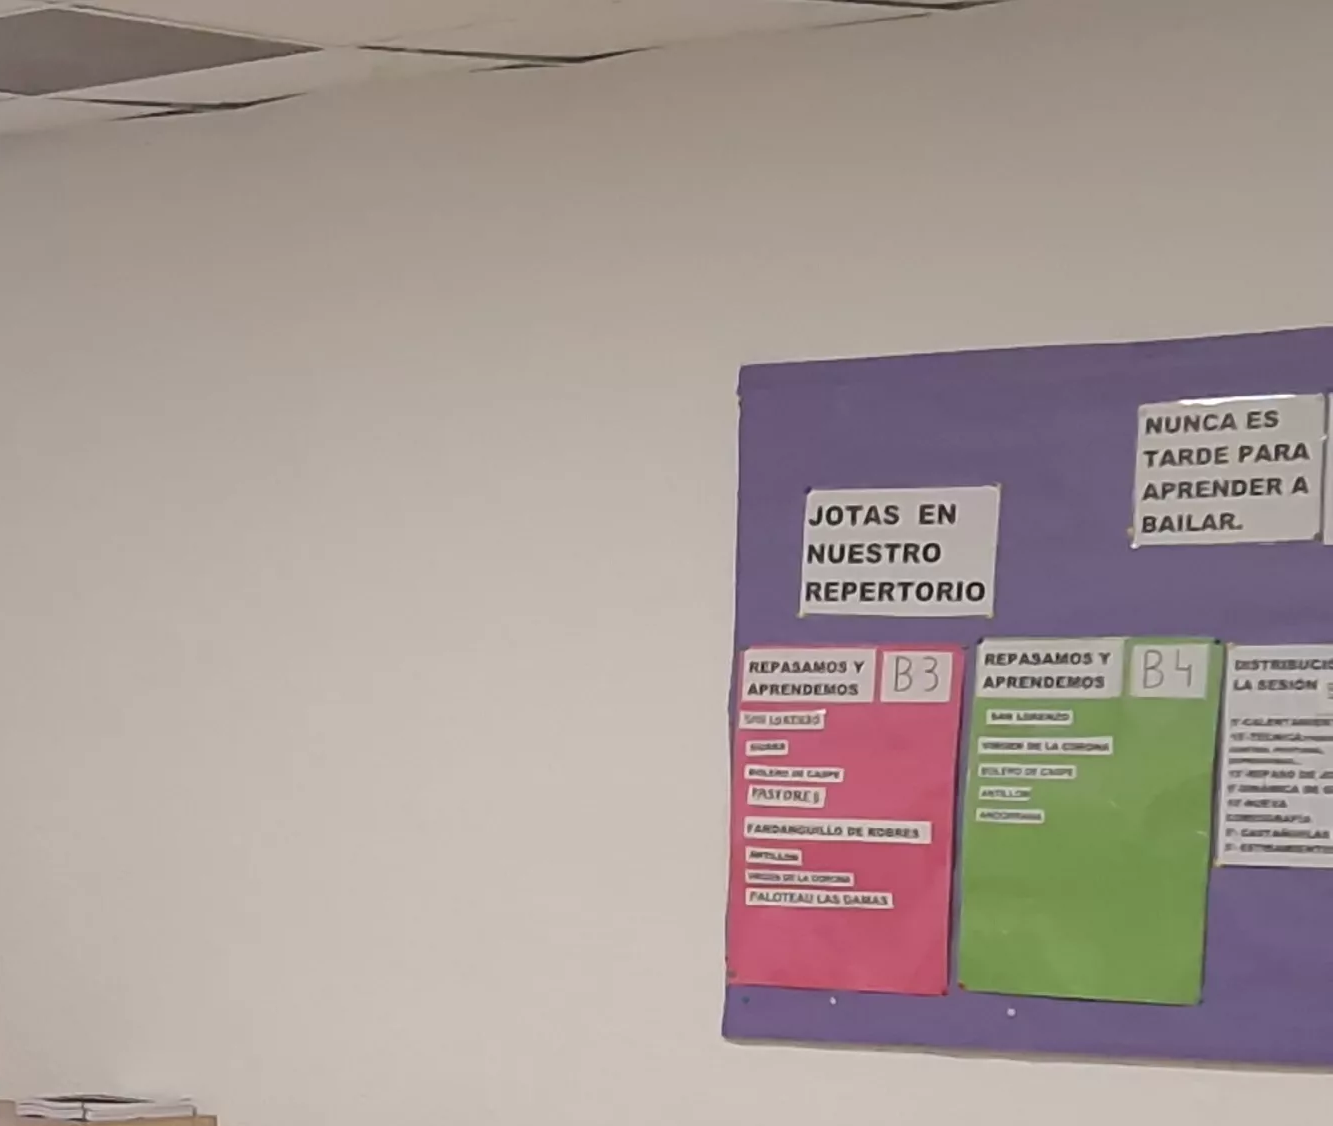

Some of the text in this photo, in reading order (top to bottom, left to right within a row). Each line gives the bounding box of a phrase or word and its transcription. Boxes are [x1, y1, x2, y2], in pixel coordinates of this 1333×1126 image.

[1145, 410, 1279, 435] NUNCA ES
[1143, 442, 1311, 468] TARDE PARA
[1141, 475, 1310, 501] APRENDER A
[808, 503, 957, 527] JOTAS EN
[1140, 512, 1244, 534] BAILAR.
[806, 542, 942, 565] NUESTRO
[805, 581, 986, 602] REPERTORIO
[749, 660, 865, 674] REPASAMOS Y
[984, 651, 1111, 666] REPASAMOS Y
[747, 683, 859, 696] APRENDEMOS
[983, 675, 1106, 689] APRENDEMOS
[1234, 679, 1252, 691] LA
